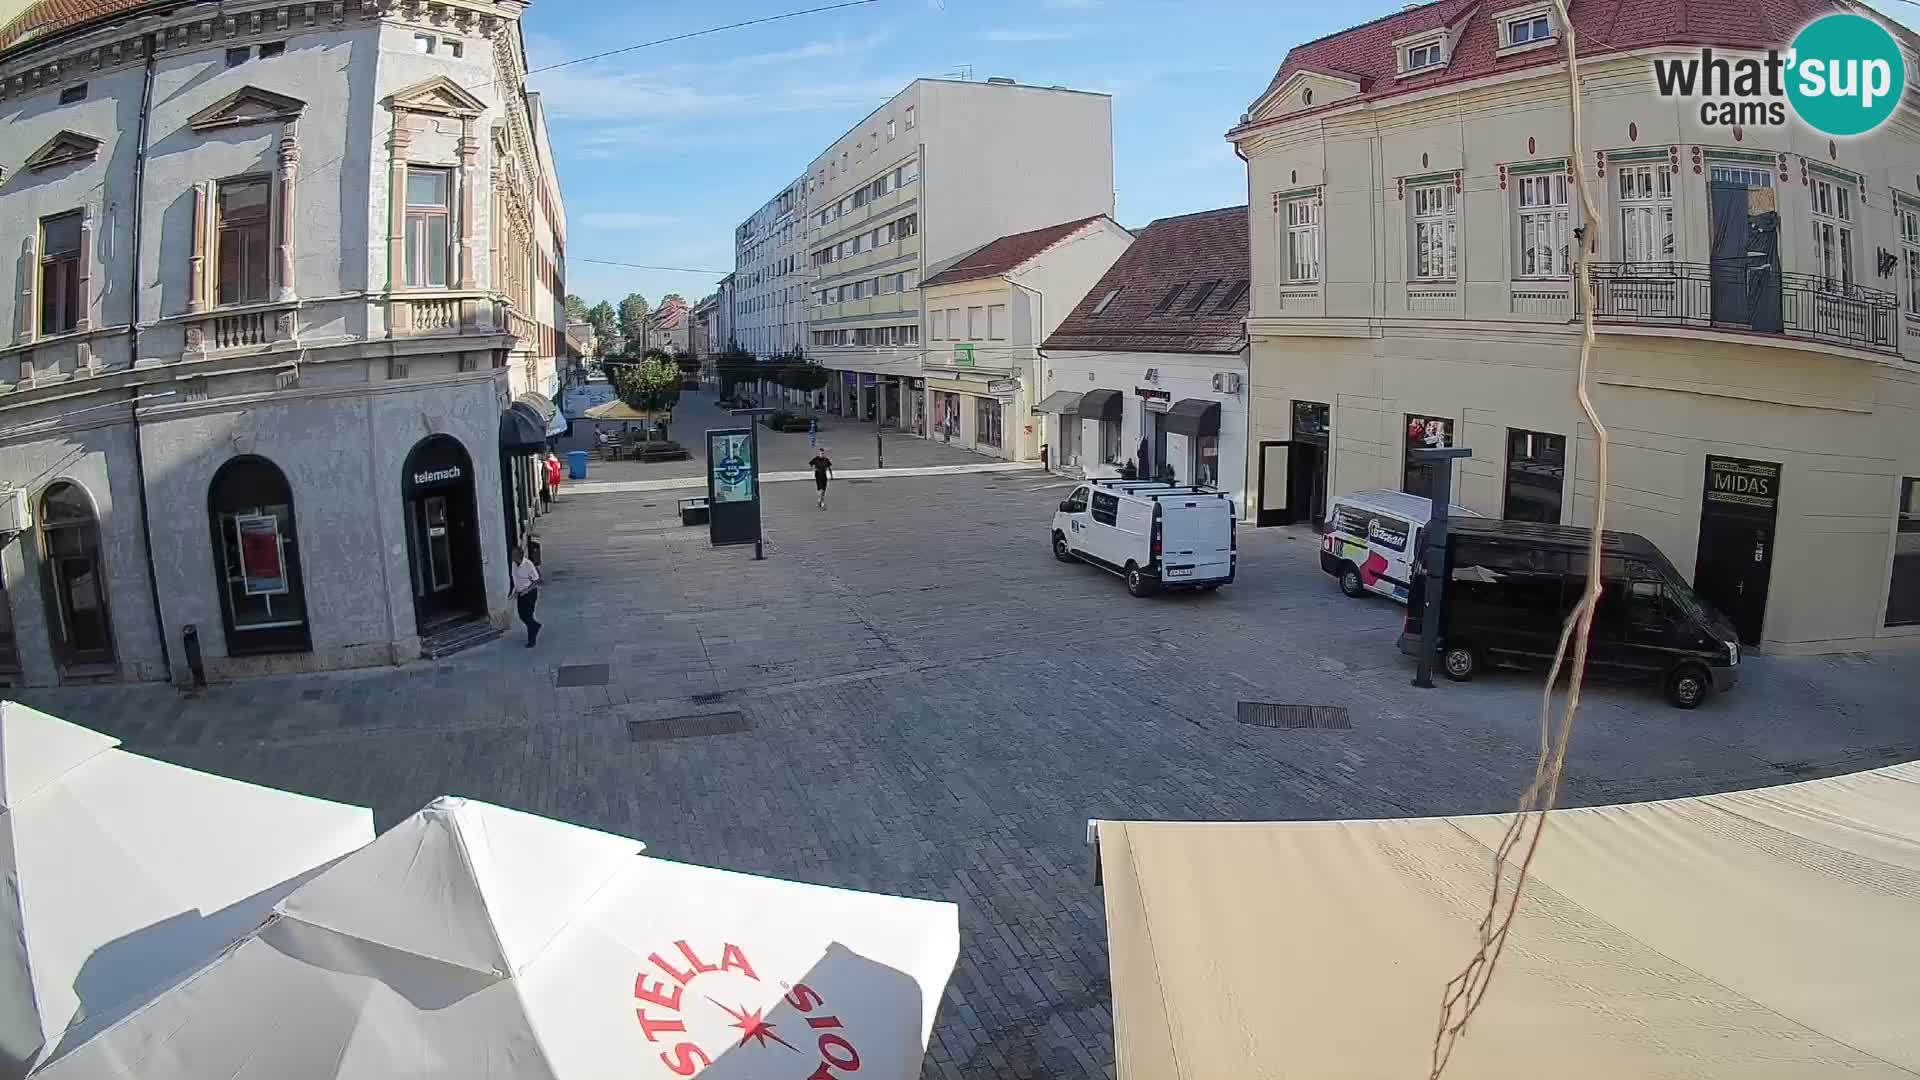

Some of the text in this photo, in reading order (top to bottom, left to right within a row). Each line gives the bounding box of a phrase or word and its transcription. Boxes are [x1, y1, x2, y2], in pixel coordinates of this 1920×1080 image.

[414, 465, 461, 485] telemach
[1714, 471, 1769, 495] MIDAS
[634, 940, 760, 1076] STELLA
